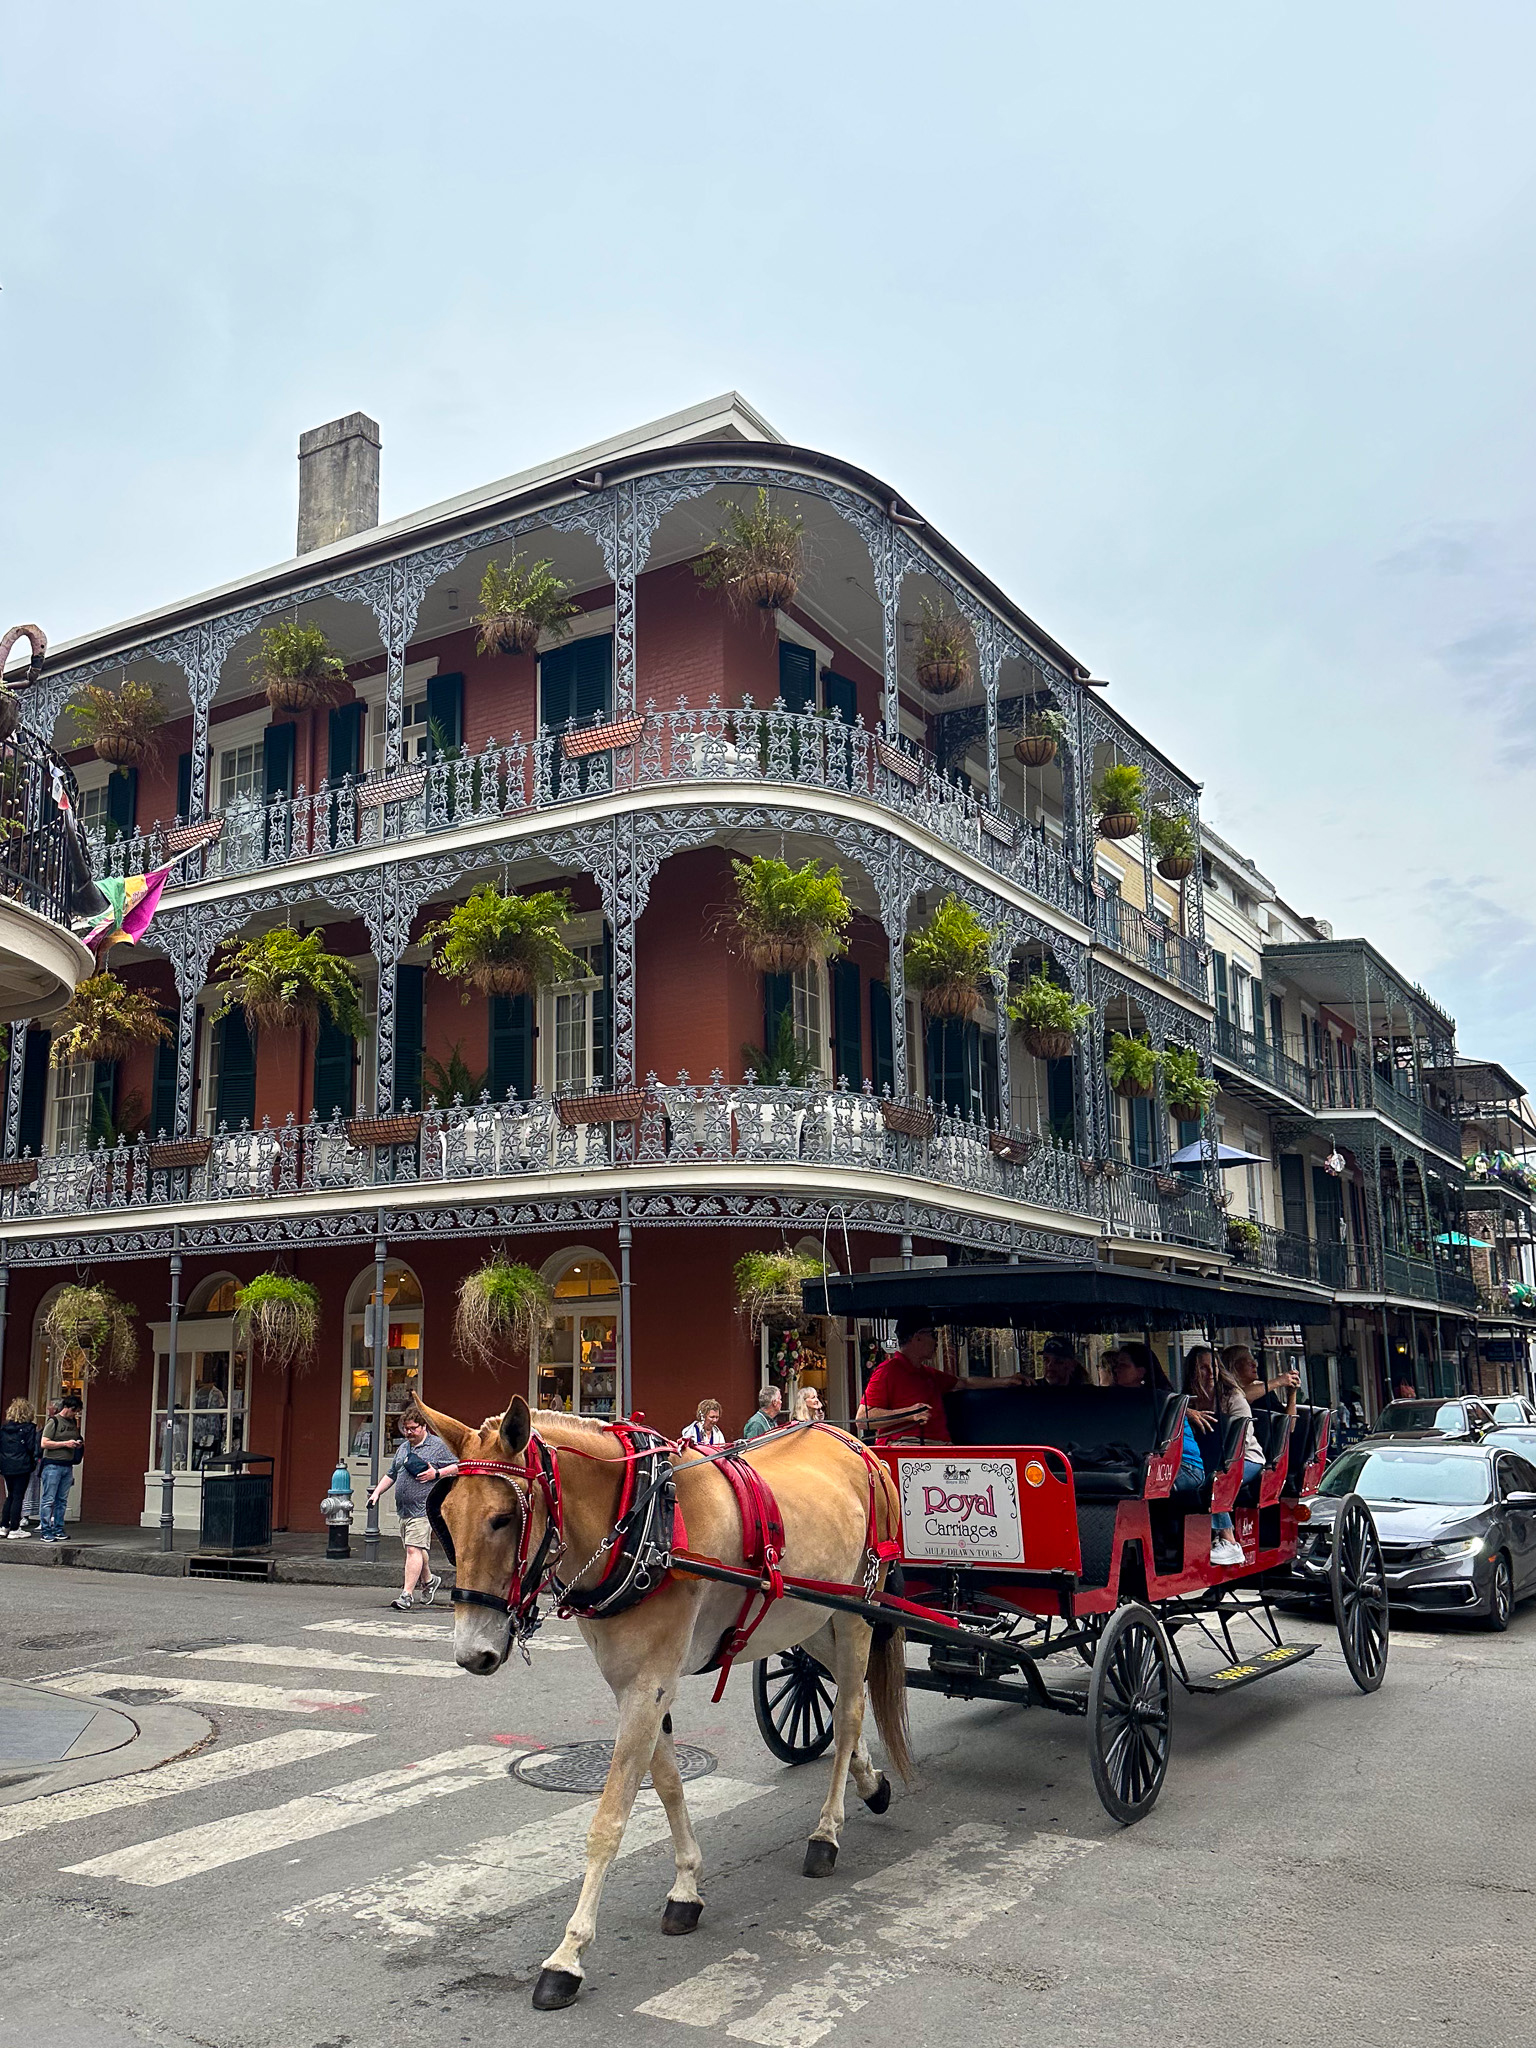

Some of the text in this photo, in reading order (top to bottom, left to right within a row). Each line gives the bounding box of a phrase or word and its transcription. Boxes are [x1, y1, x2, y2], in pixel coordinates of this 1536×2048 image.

[922, 1484, 997, 1522] Royal
[925, 1518, 998, 1544] Carriages
[976, 1549, 1003, 1558] TOURS
